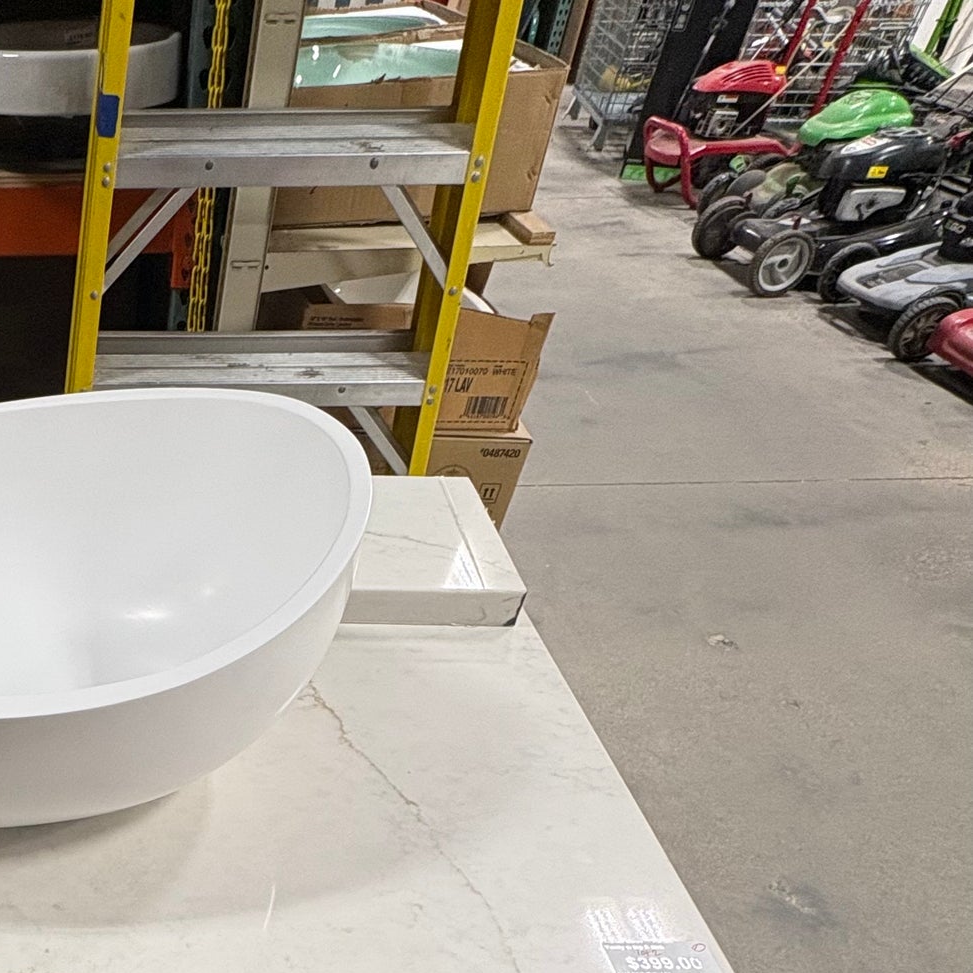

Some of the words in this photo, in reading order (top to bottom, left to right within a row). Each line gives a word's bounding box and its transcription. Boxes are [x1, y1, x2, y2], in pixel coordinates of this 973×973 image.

[492, 367, 517, 376] WHITE
[454, 377, 474, 392] LAV
[625, 956, 703, 970] $399.00
